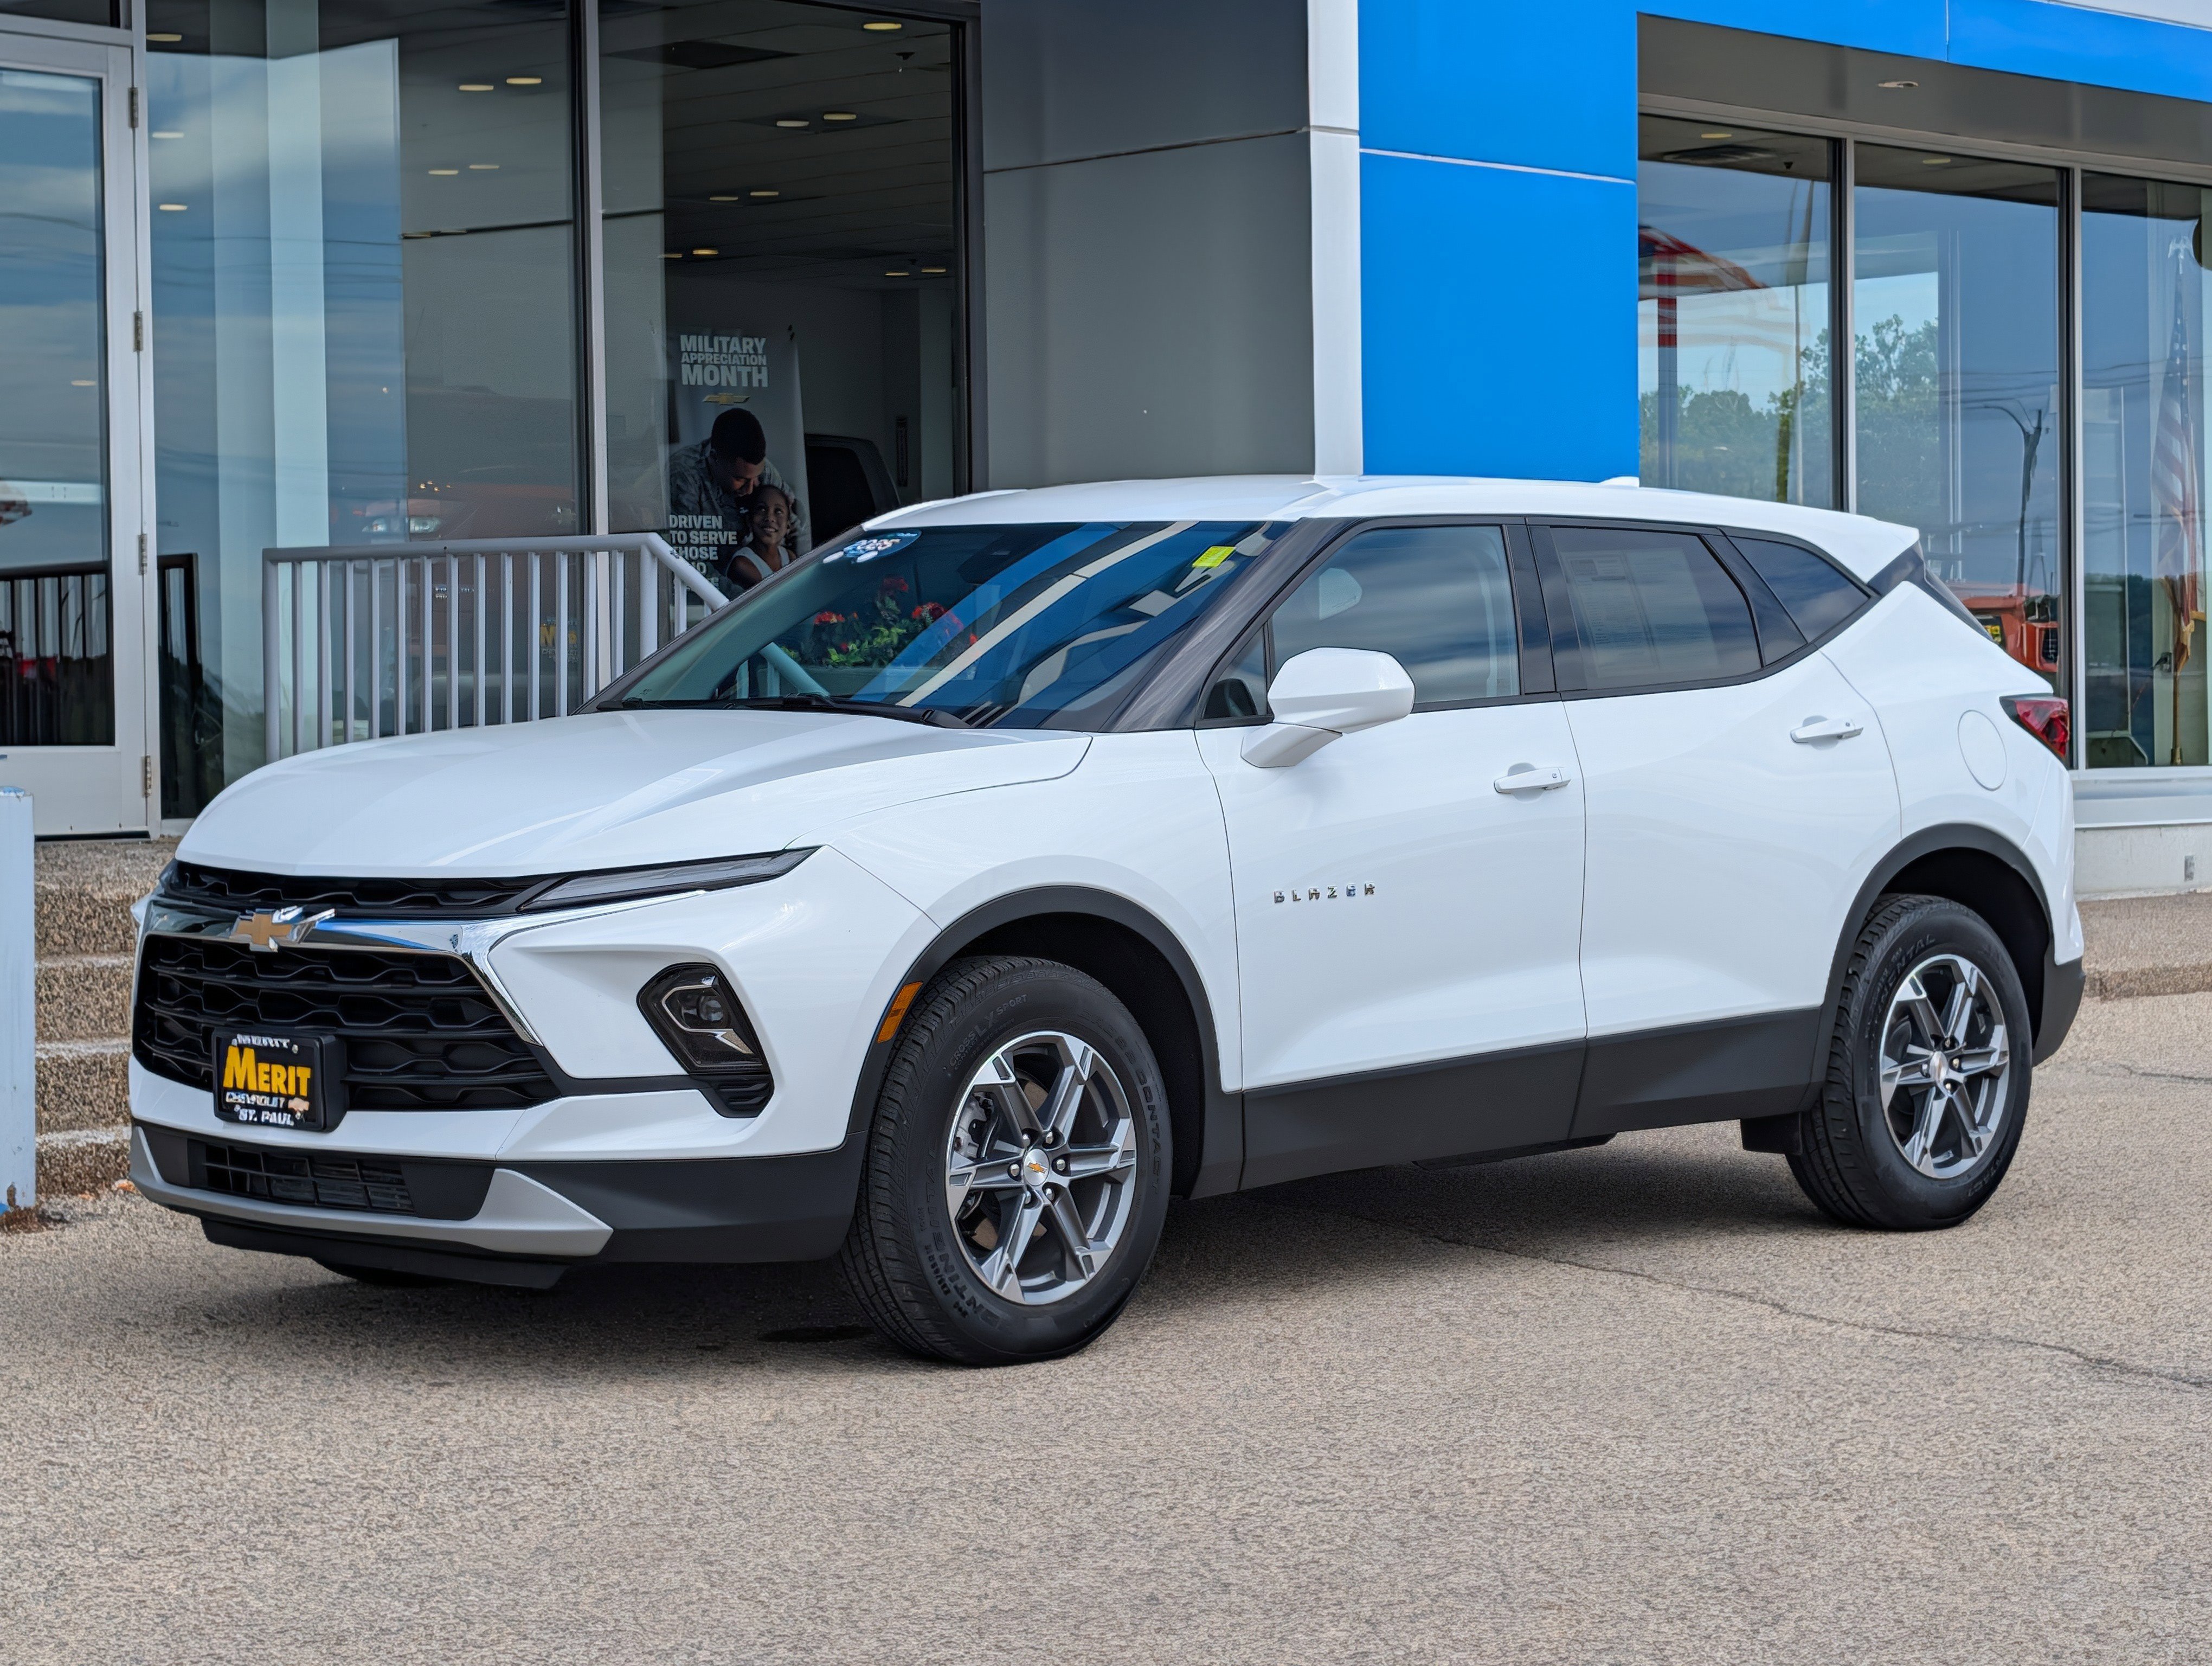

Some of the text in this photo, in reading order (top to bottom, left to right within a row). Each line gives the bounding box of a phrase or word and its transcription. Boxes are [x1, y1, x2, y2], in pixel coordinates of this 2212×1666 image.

[680, 335, 767, 354] MILITARY
[681, 353, 767, 366] APPRECIATION
[681, 364, 769, 387] MONTH
[670, 515, 723, 529] DRIVEN
[671, 530, 738, 545] TO SERVE
[1274, 881, 1375, 904] BLAZER
[996, 994, 1027, 1015] SPORT
[223, 1045, 311, 1097] MERIT
